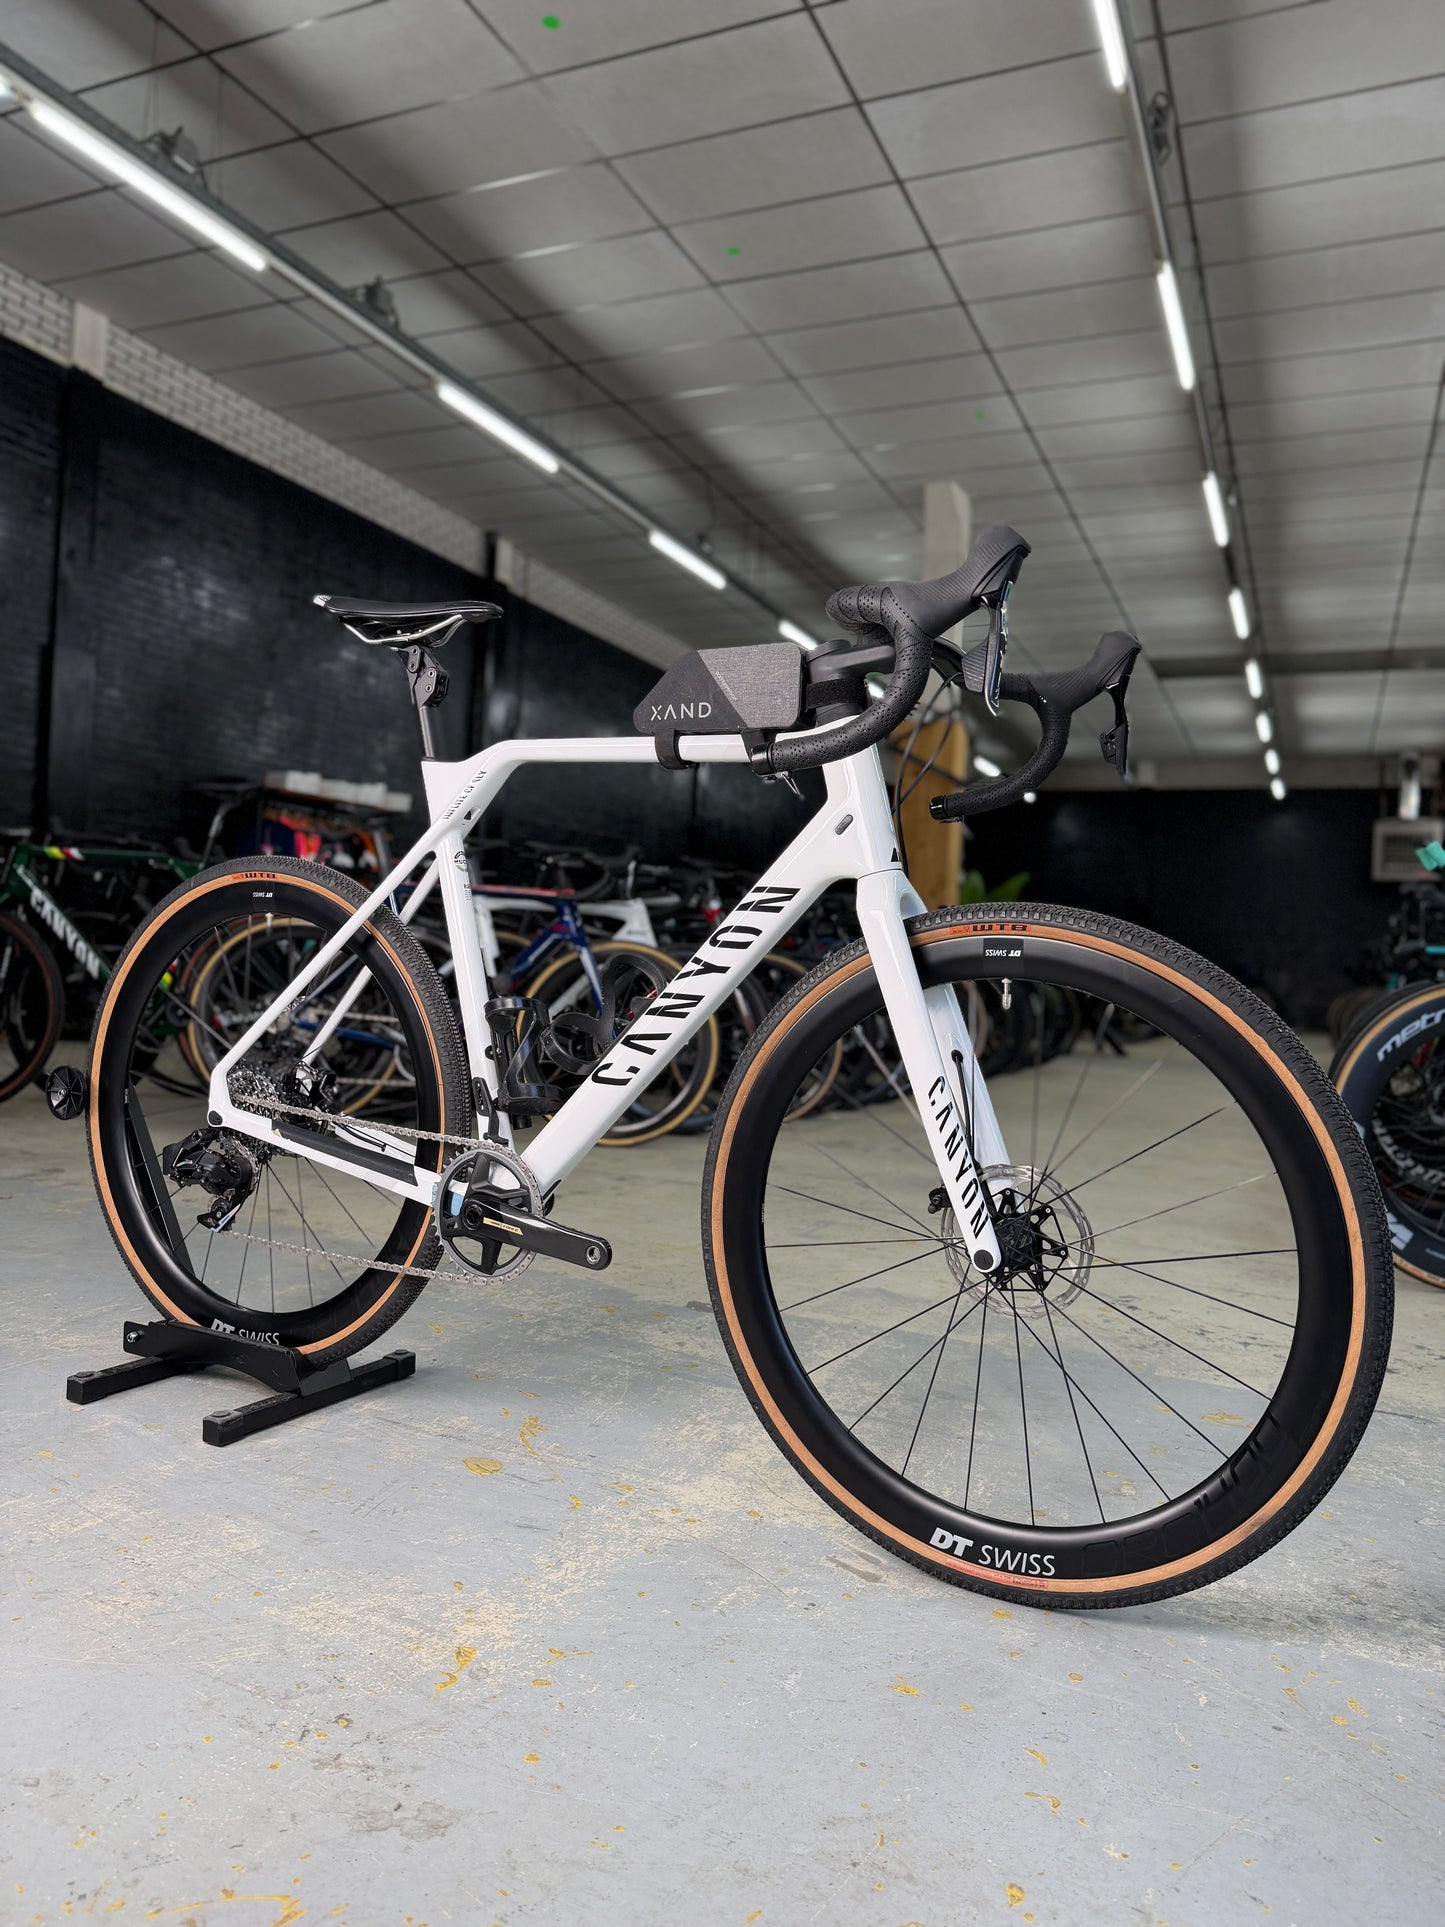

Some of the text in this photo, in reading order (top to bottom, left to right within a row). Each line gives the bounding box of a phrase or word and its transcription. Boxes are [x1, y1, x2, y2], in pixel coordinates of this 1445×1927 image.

[650, 702, 712, 721] XAND
[30, 887, 101, 980] CANYON
[972, 923, 1028, 932] WTB
[985, 949, 1021, 957] DT SWISS
[590, 886, 802, 1087] CANYON
[928, 1075, 989, 1239] CANYON
[929, 1527, 974, 1557] DT
[978, 1545, 1056, 1576] SWISS
